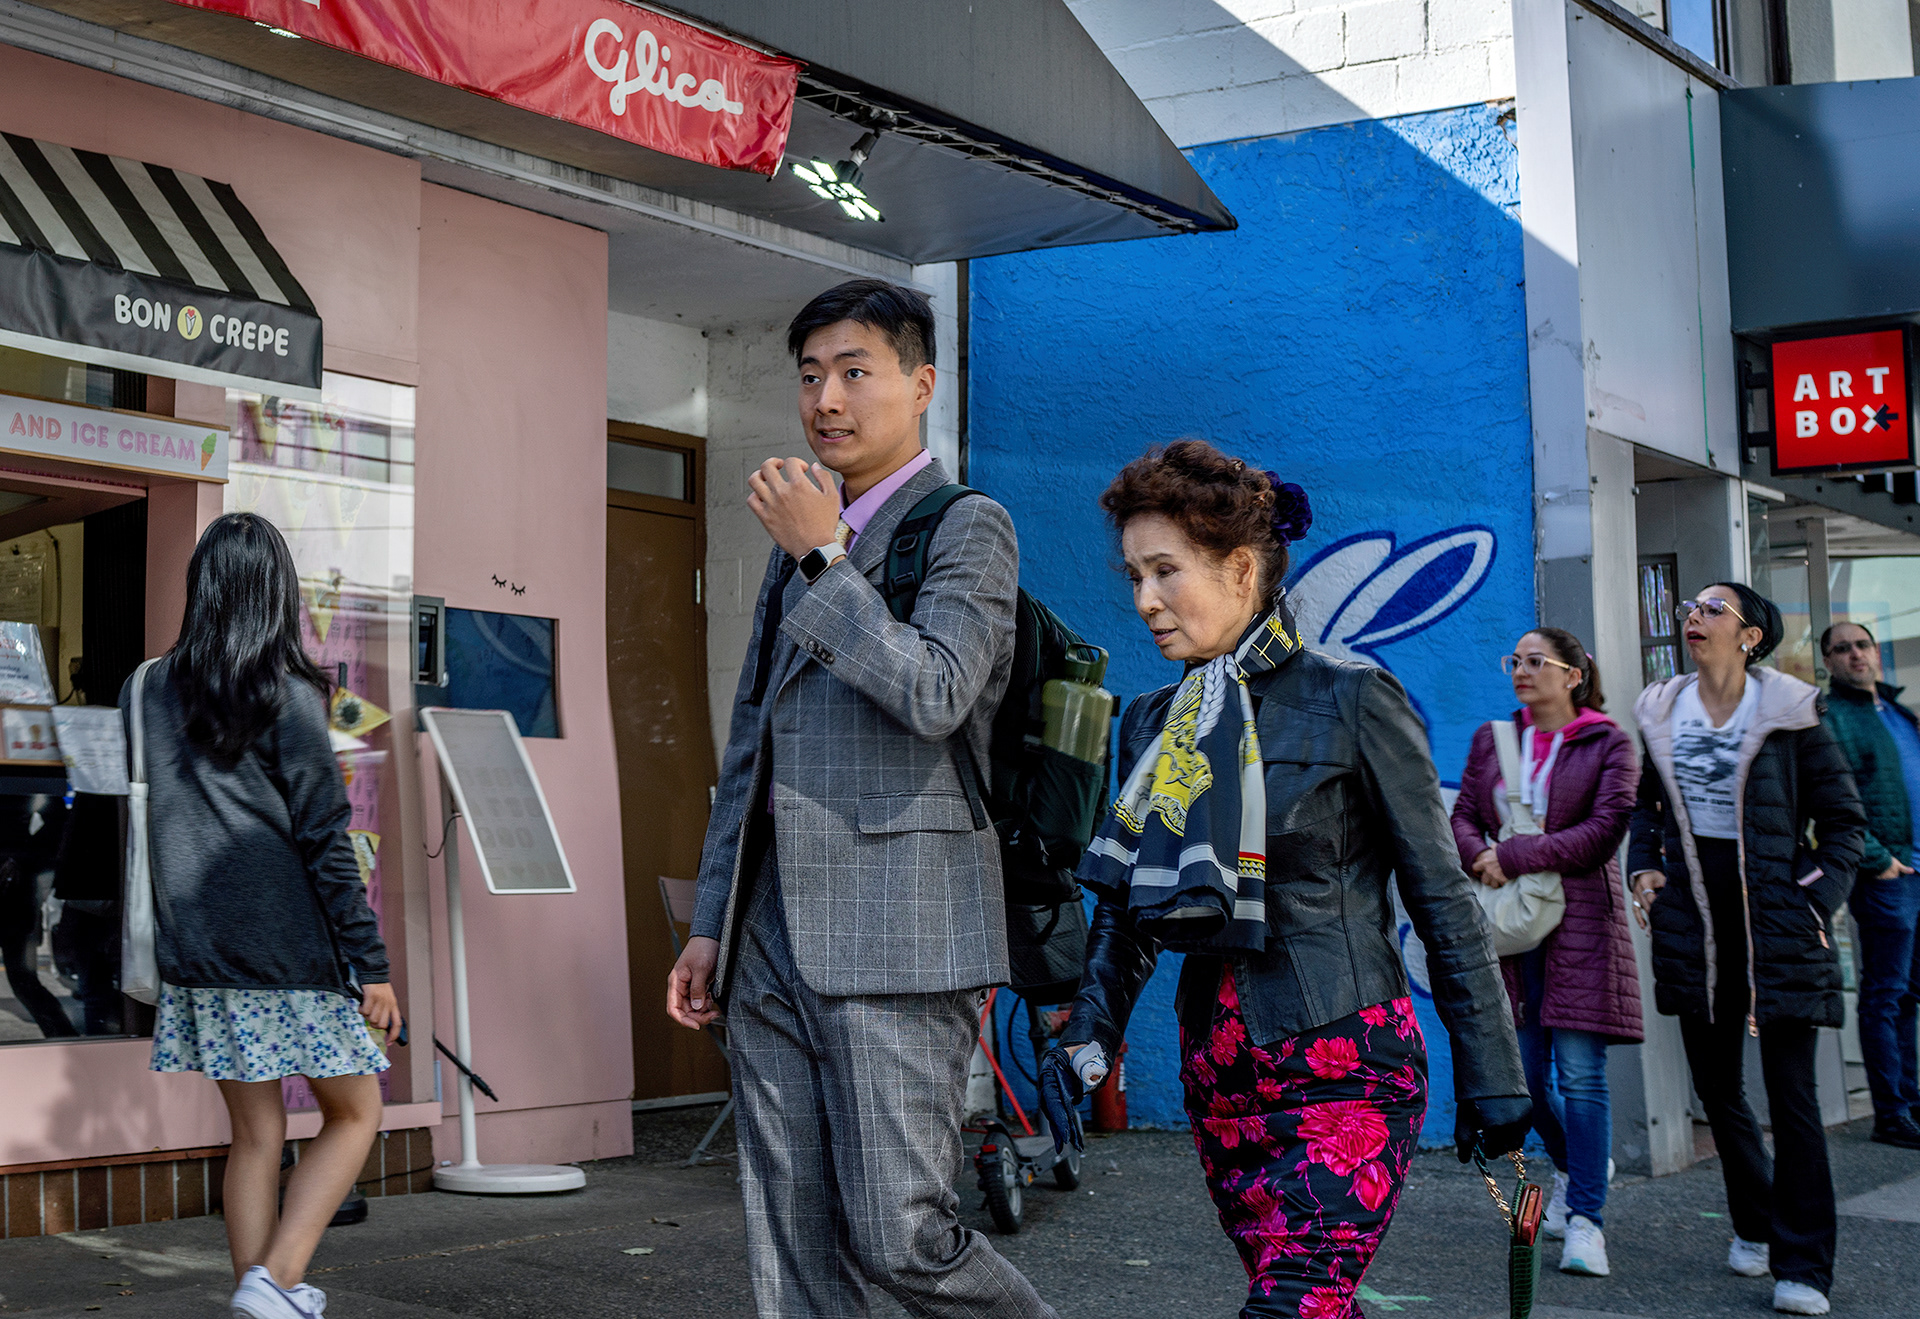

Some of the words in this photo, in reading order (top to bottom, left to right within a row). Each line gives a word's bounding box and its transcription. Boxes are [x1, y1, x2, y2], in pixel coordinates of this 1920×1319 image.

[584, 18, 744, 116] Glico
[114, 294, 171, 332] BON
[210, 314, 290, 357] CREPE
[1793, 366, 1890, 402] ART
[9, 412, 62, 440] AND
[71, 421, 109, 448] ICE
[117, 429, 196, 461] CREAM
[1795, 404, 1891, 438] BOX
